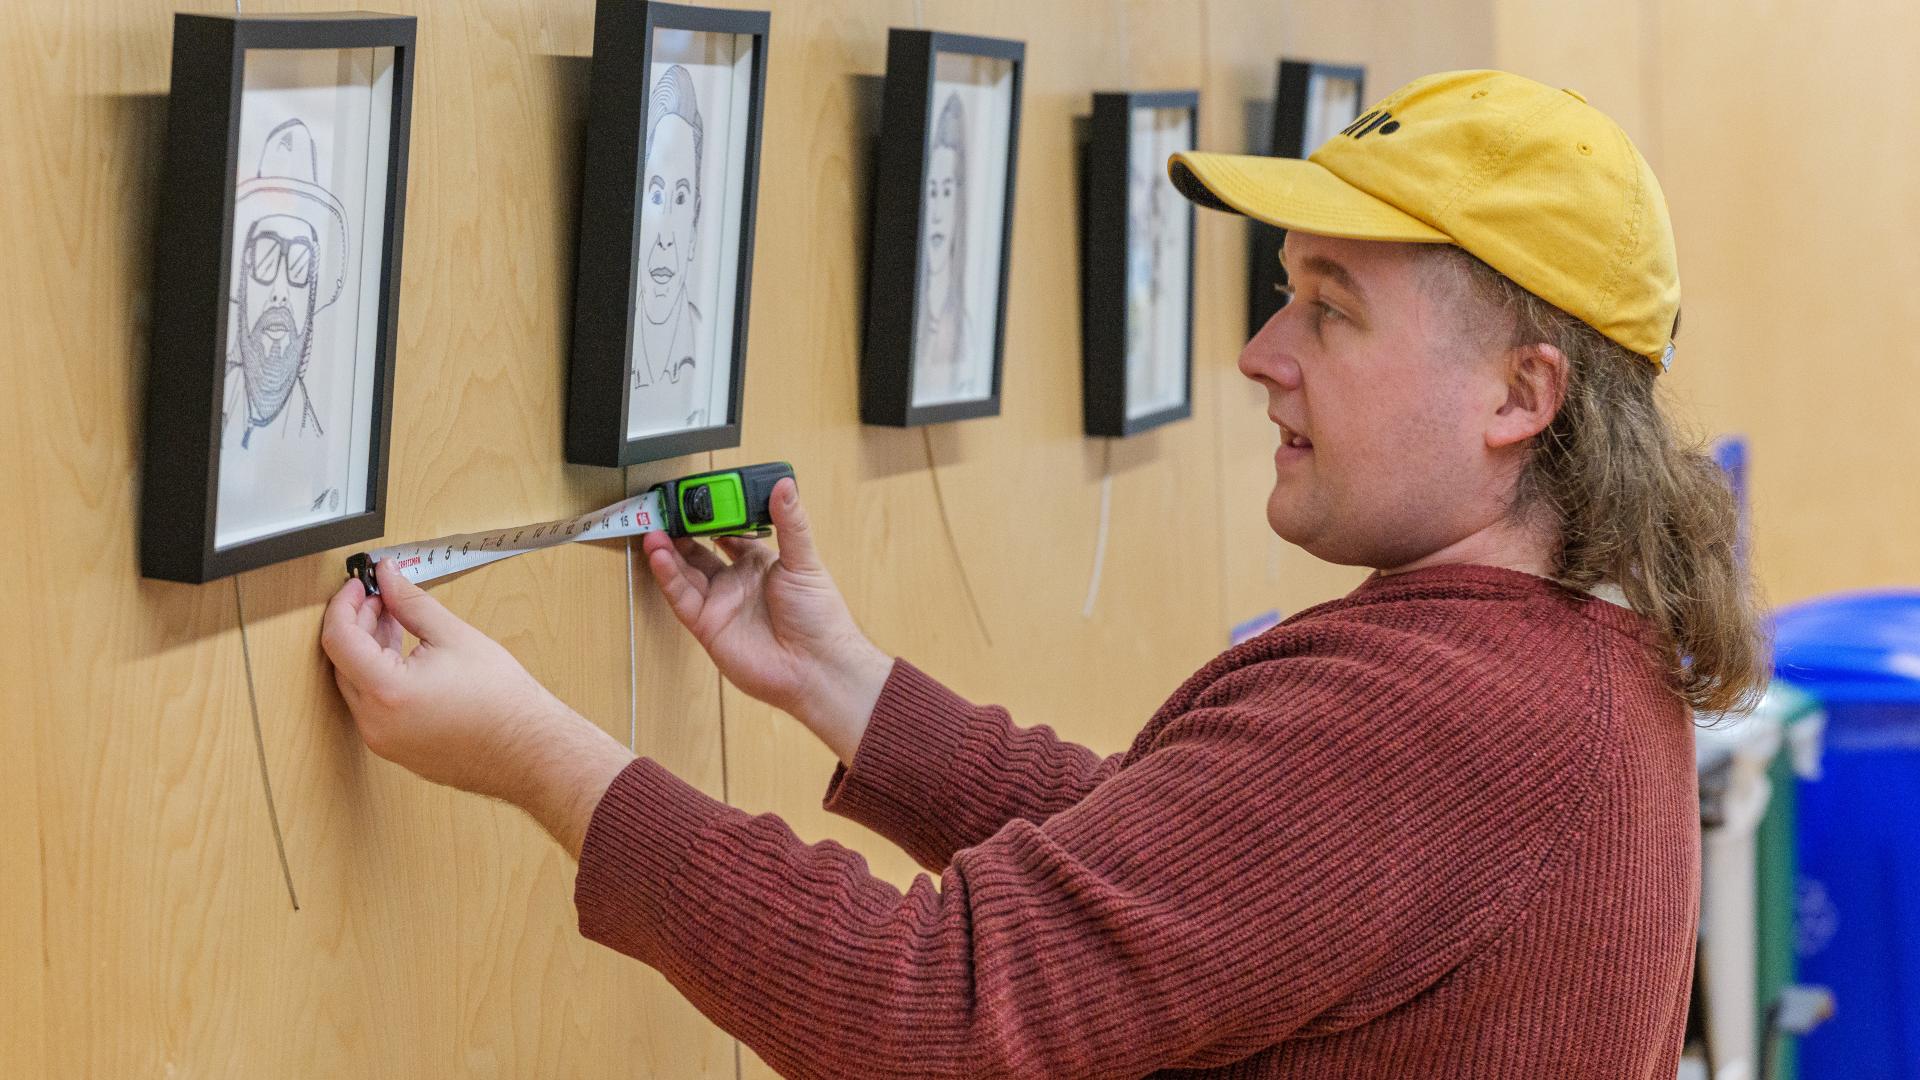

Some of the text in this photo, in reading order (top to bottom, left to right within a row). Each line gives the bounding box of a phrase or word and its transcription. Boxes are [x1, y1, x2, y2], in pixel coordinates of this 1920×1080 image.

[428, 549, 434, 565] 4
[444, 545, 452, 561] 5
[462, 541, 470, 556] 6
[480, 538, 488, 551] 7
[496, 534, 506, 547] 8
[582, 521, 591, 532] 13
[601, 517, 609, 529] 14
[620, 515, 629, 527] 15
[637, 512, 649, 525] 16
